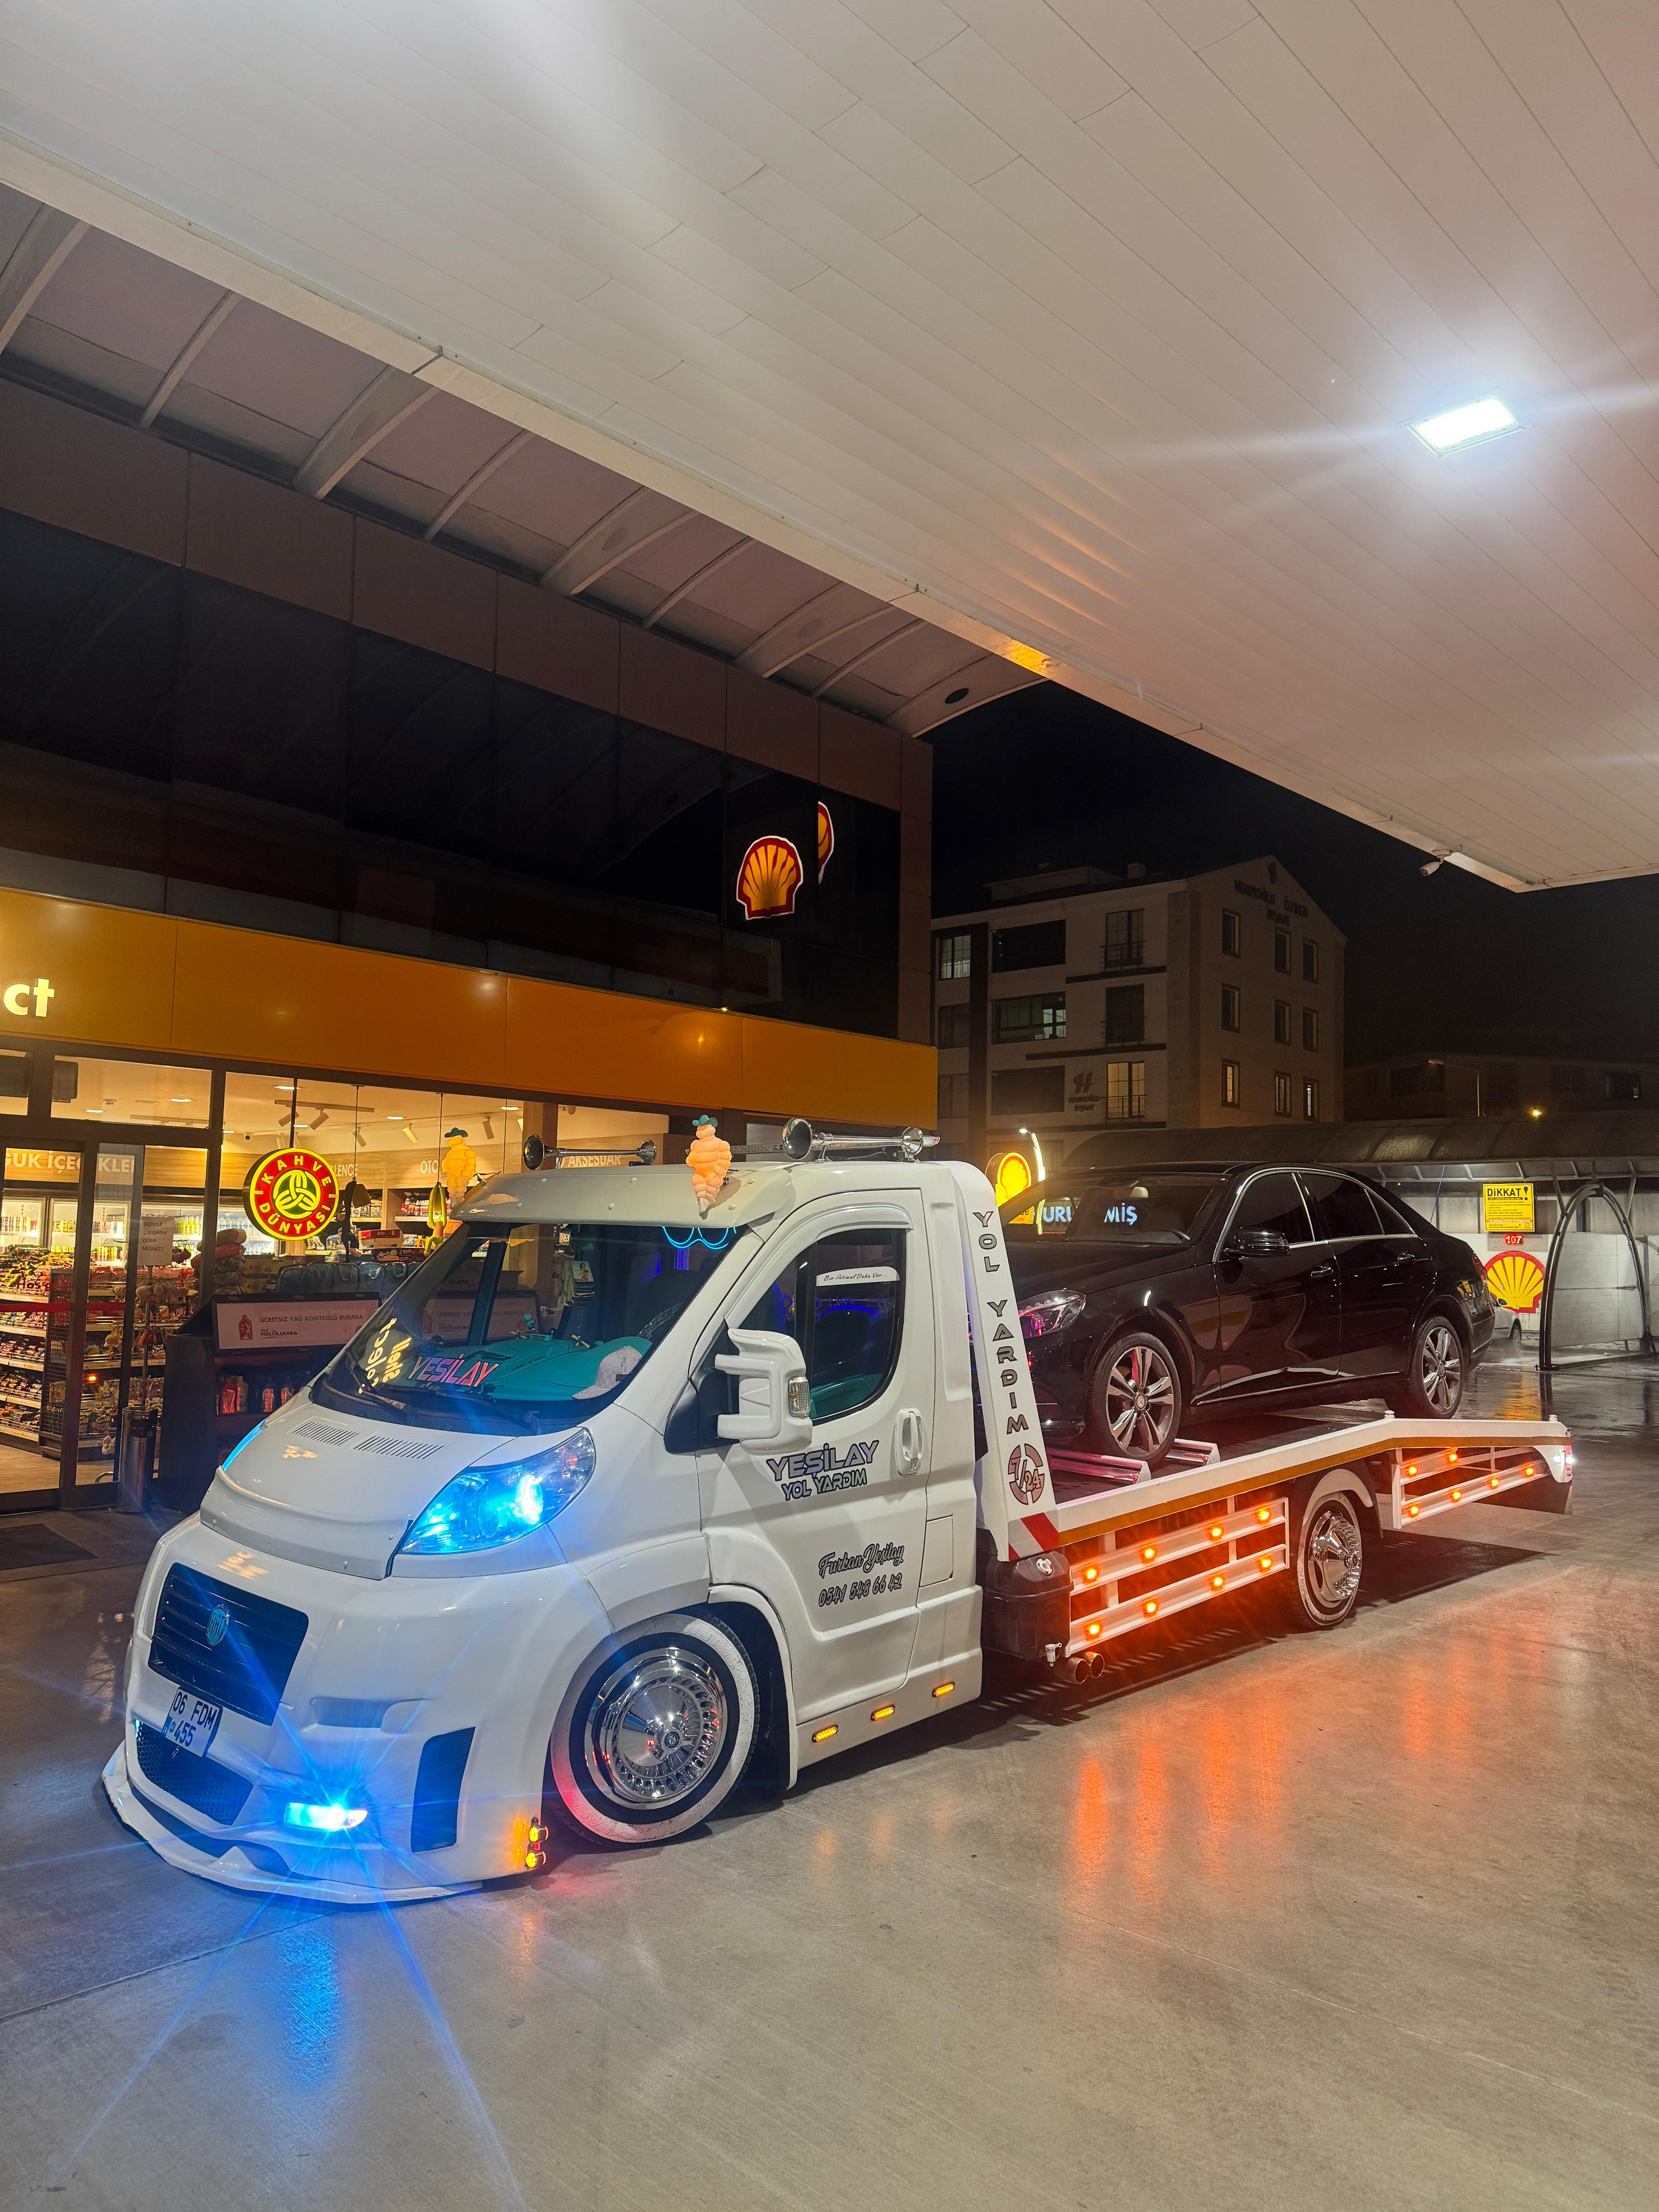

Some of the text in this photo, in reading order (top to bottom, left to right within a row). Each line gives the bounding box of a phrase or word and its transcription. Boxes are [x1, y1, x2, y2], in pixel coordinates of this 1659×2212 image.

[261, 1155, 331, 1186] KAHVE
[420, 1160, 439, 1174] OTO
[568, 1155, 621, 1167] AKSESUAR
[1487, 1188, 1521, 1197] DİKKAT
[259, 1202, 331, 1234] DÜNYASI
[972, 1211, 1029, 1435] YOL YARDIM
[766, 1440, 879, 1481] YEŞİLAY
[781, 1468, 868, 1501] YOL YARDIM
[818, 1542, 904, 1579] Furkan Yeşilay
[819, 1573, 902, 1607] 0541 548 66 42
[208, 1612, 226, 1637] FIAT
[173, 1691, 217, 1730] 06 FDM
[174, 1720, 196, 1747] 455
